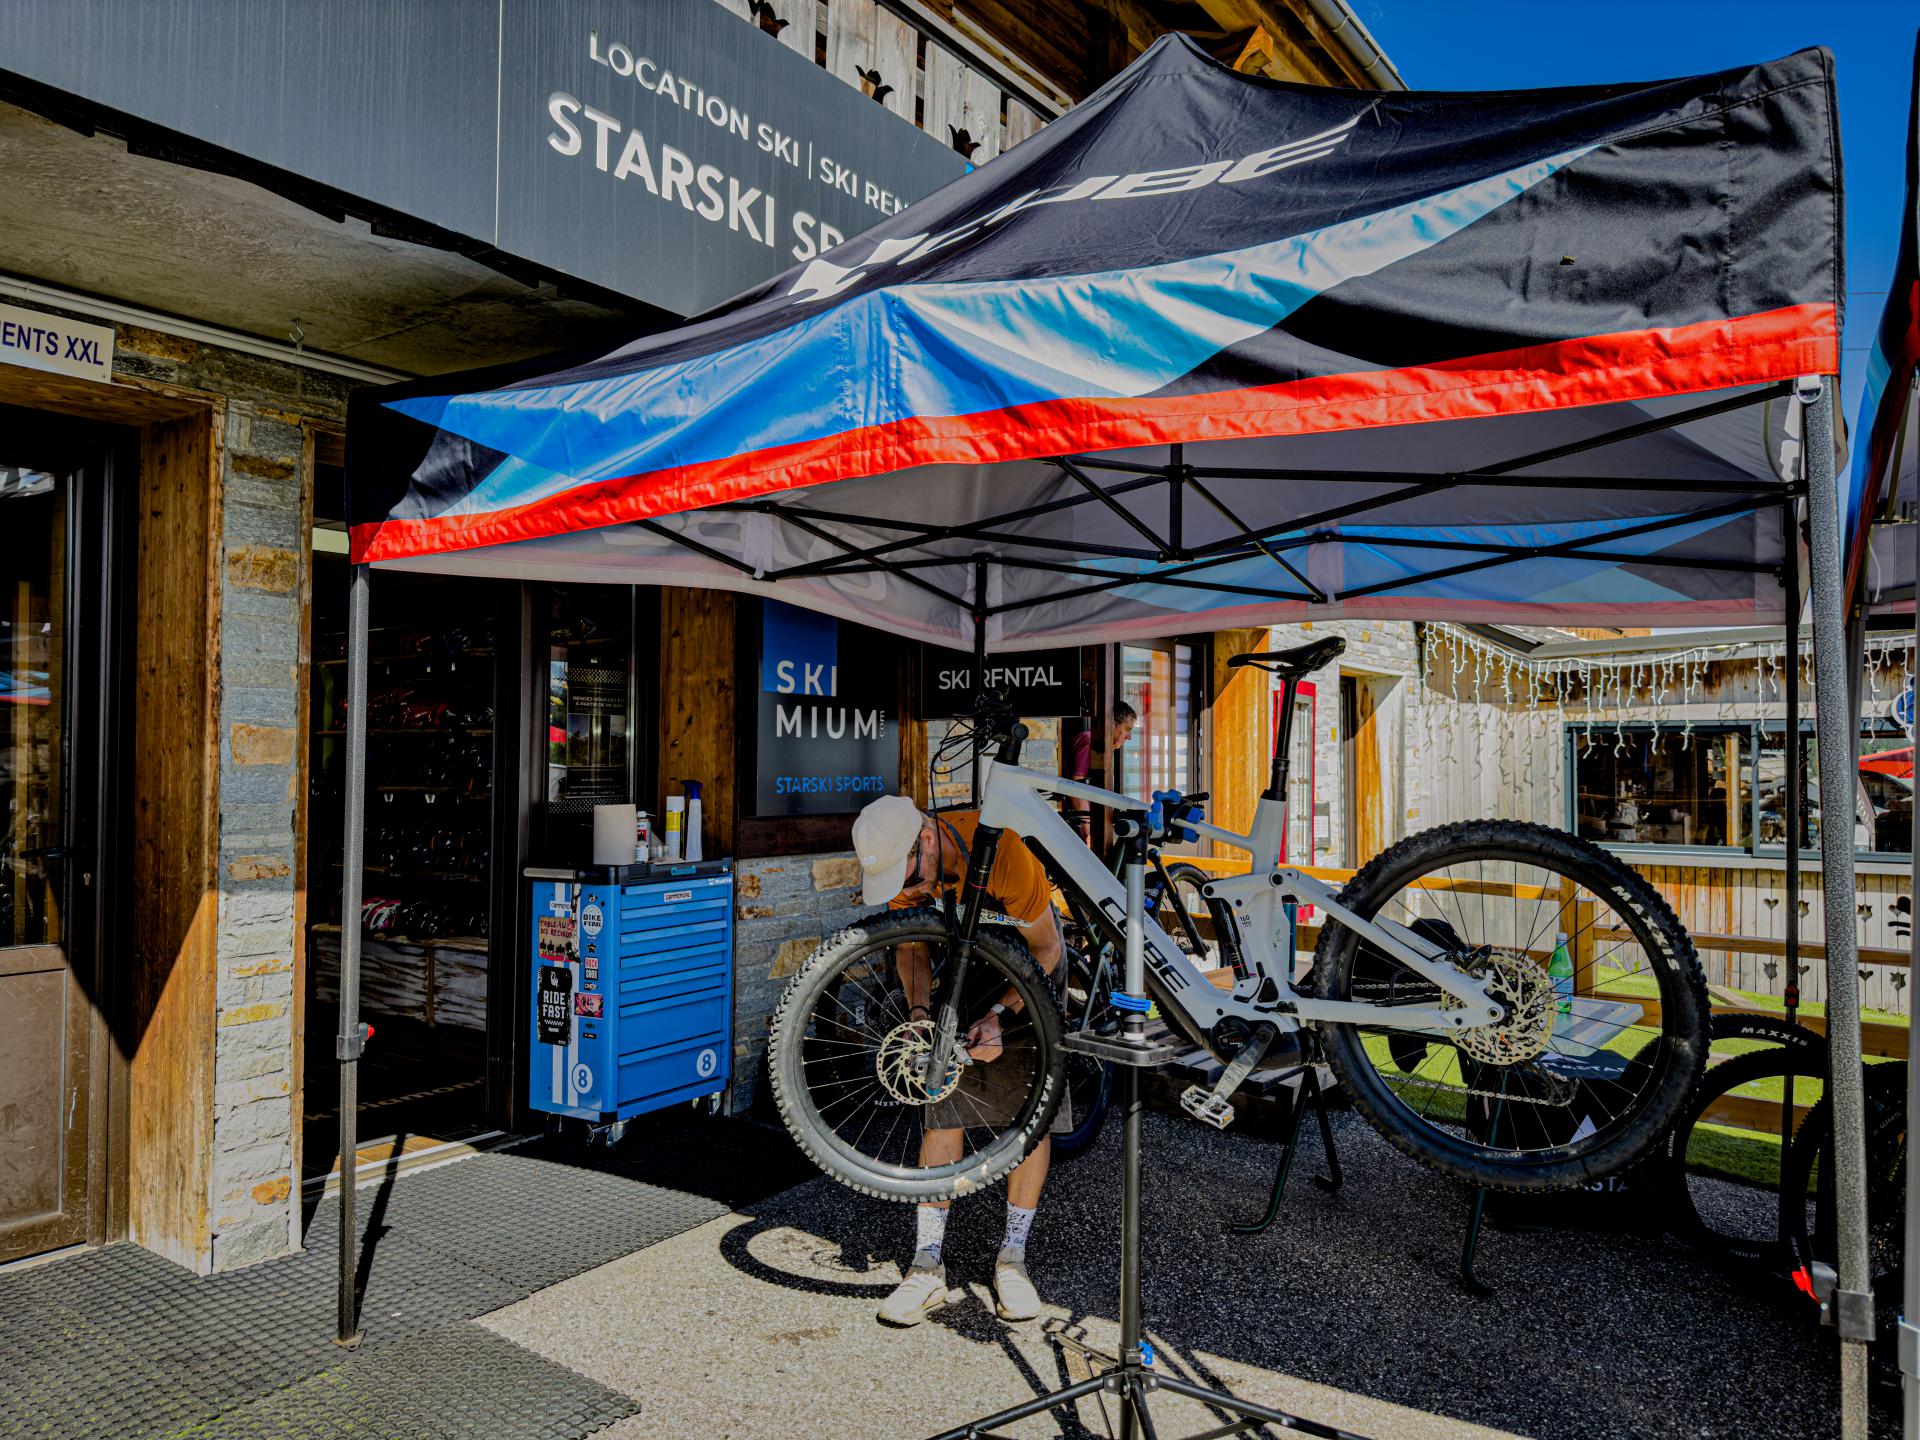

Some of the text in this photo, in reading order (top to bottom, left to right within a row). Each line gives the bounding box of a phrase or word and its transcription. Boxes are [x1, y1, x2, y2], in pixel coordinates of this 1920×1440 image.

[589, 28, 910, 217] LOCATION SKI SKI REN
[547, 91, 846, 262] STARSKI SP
[1, 321, 105, 366] ENTS XXL
[775, 659, 838, 697] SKI
[938, 665, 1063, 691] SKI RENTAL
[775, 704, 878, 741] MIUM
[775, 776, 885, 794] STARSKI SPORTS
[583, 913, 602, 922] BIKE
[1611, 885, 1681, 970] MAXXIS
[543, 990, 566, 1006] RIDE
[542, 1004, 566, 1019] FAST
[1740, 1026, 1808, 1046] MAXXIS
[702, 1052, 713, 1074] 8
[578, 1069, 588, 1088] 8
[1019, 1073, 1054, 1145] MAXXIS
